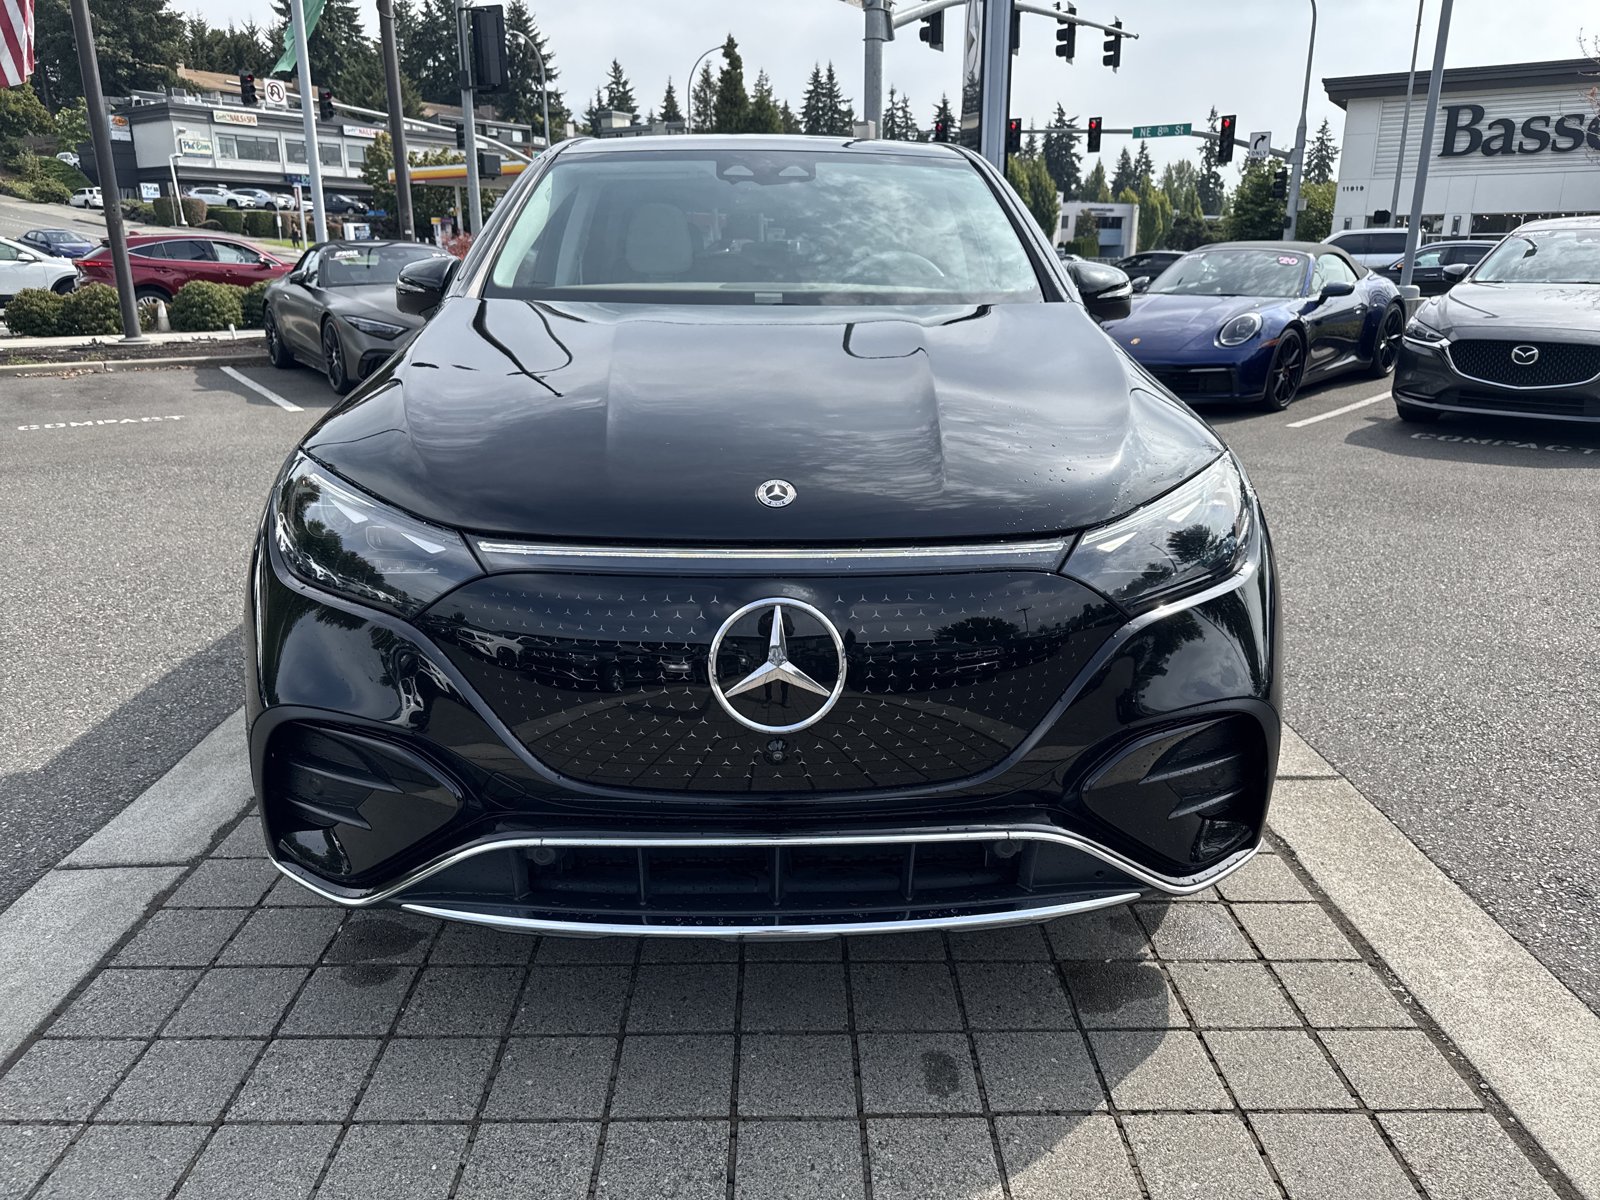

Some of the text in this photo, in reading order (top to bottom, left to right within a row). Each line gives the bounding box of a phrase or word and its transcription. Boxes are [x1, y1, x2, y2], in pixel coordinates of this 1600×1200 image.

[1140, 125, 1184, 137] NE 8th St
[17, 415, 185, 431] COMPACT
[1410, 432, 1598, 455] COMPACT
